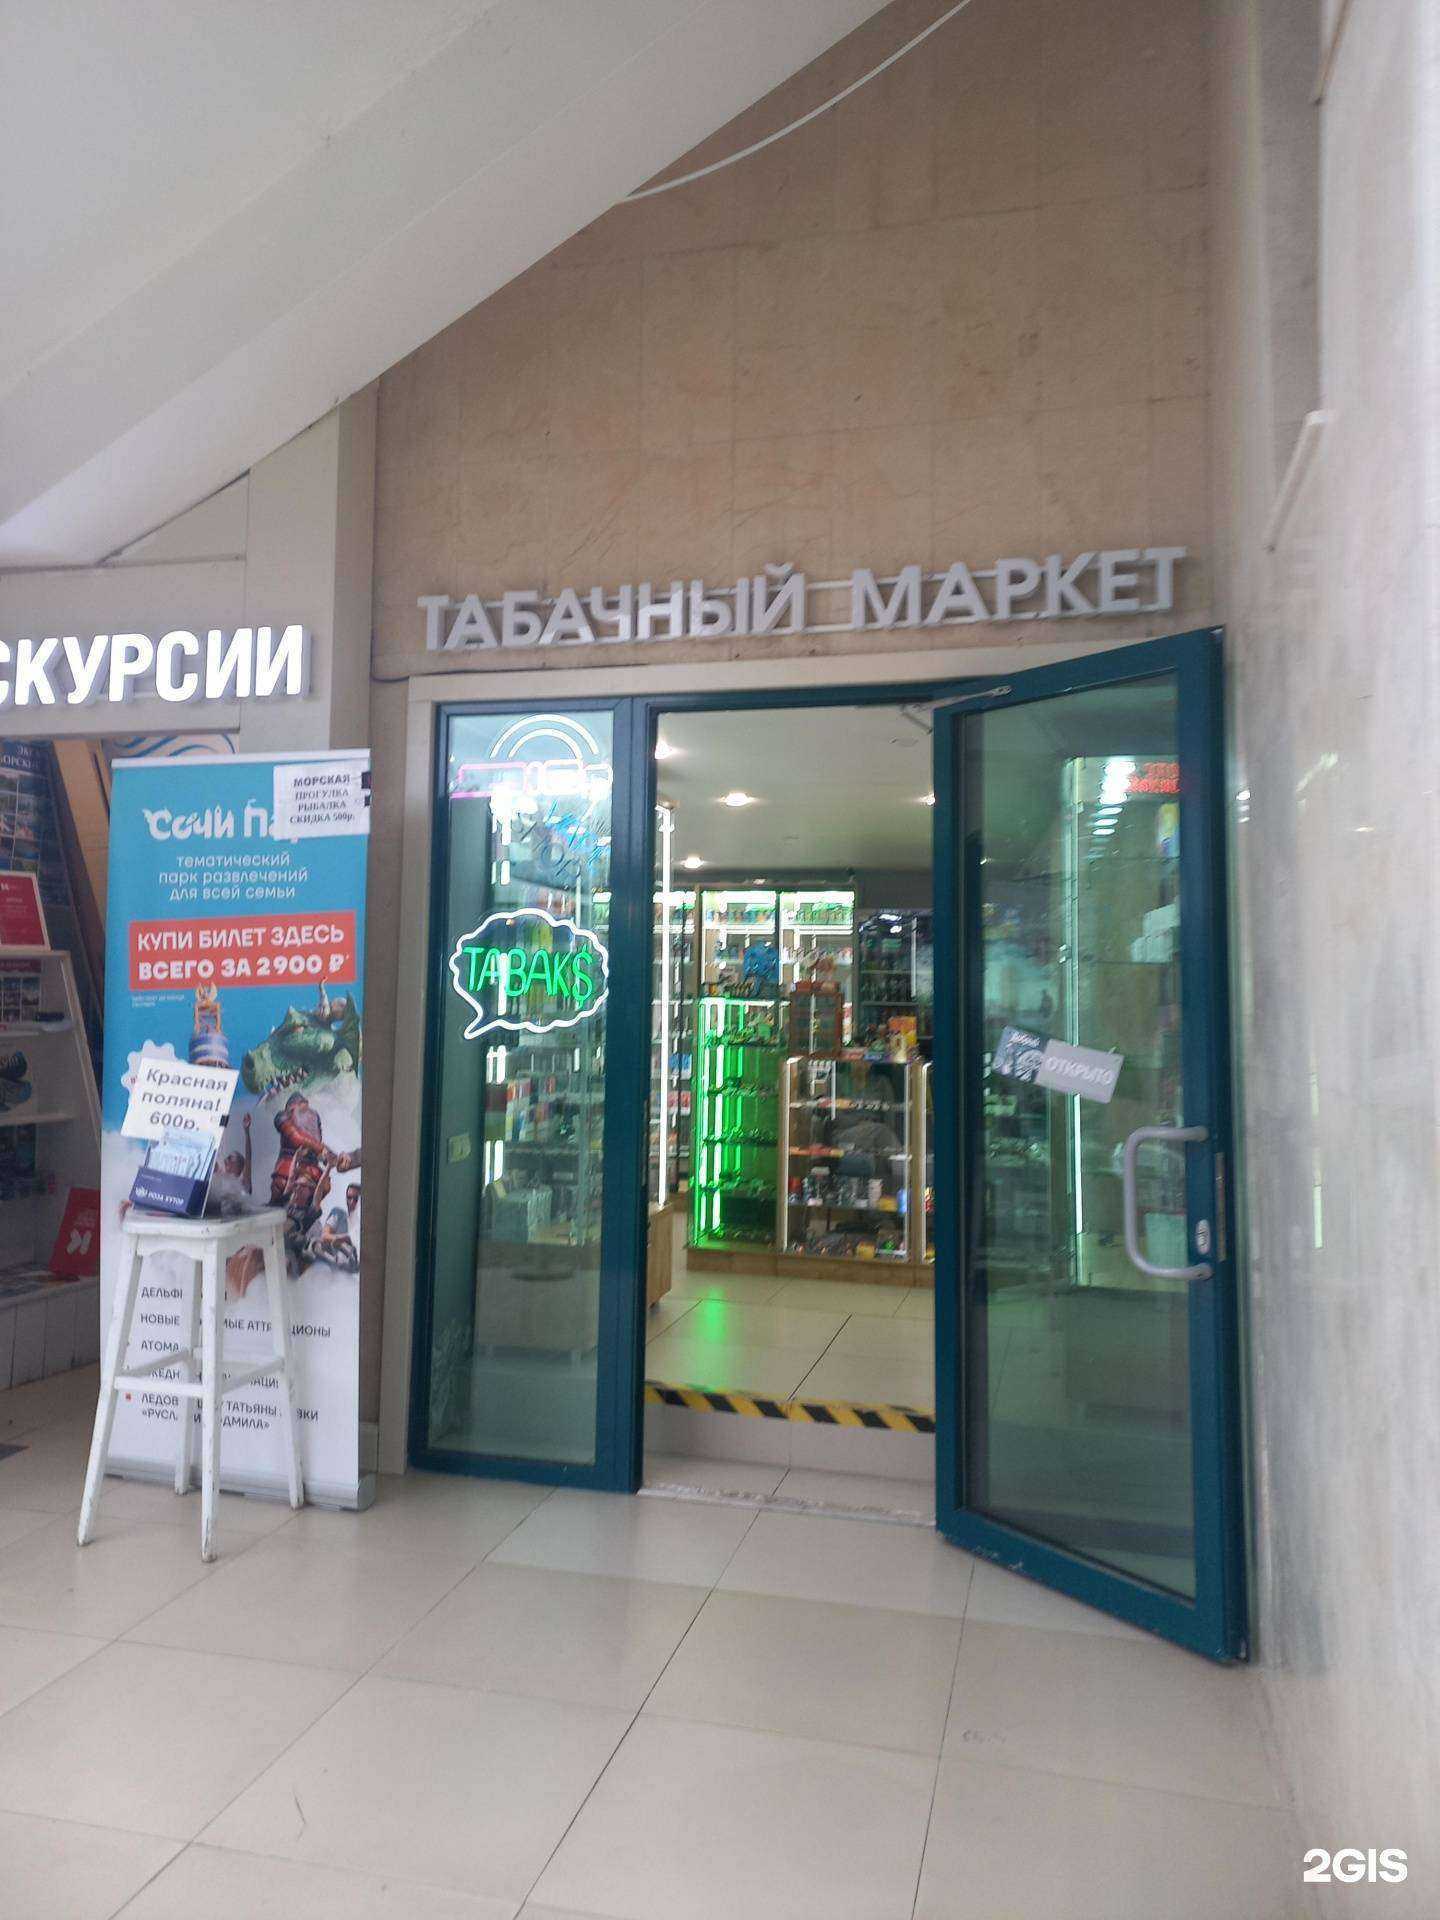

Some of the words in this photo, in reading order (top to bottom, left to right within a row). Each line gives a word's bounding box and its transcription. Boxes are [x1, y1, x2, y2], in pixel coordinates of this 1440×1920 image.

[417, 562, 806, 651] ТАБАЧНЫЙ
[851, 546, 1187, 631] МАРКЕТ
[293, 774, 350, 788] МОРСКАЯ
[176, 851, 290, 869] тематический
[159, 871, 198, 887] парк
[203, 866, 308, 886] развлечений
[170, 886, 198, 901] для
[203, 884, 240, 899] всей
[245, 885, 296, 899] семьи
[137, 931, 193, 951] КУПИ
[199, 928, 267, 949] БИЛЕТ
[271, 924, 344, 948] ЗДЕСЬ
[138, 958, 215, 981] ВСЕГО
[221, 957, 251, 978] ЗА
[146, 1068, 228, 1091] Красная
[141, 1091, 222, 1112] поляна!
[140, 1313, 180, 1326] НОВЫЕ
[226, 1400, 277, 1417] ТАТЬЯНЫ
